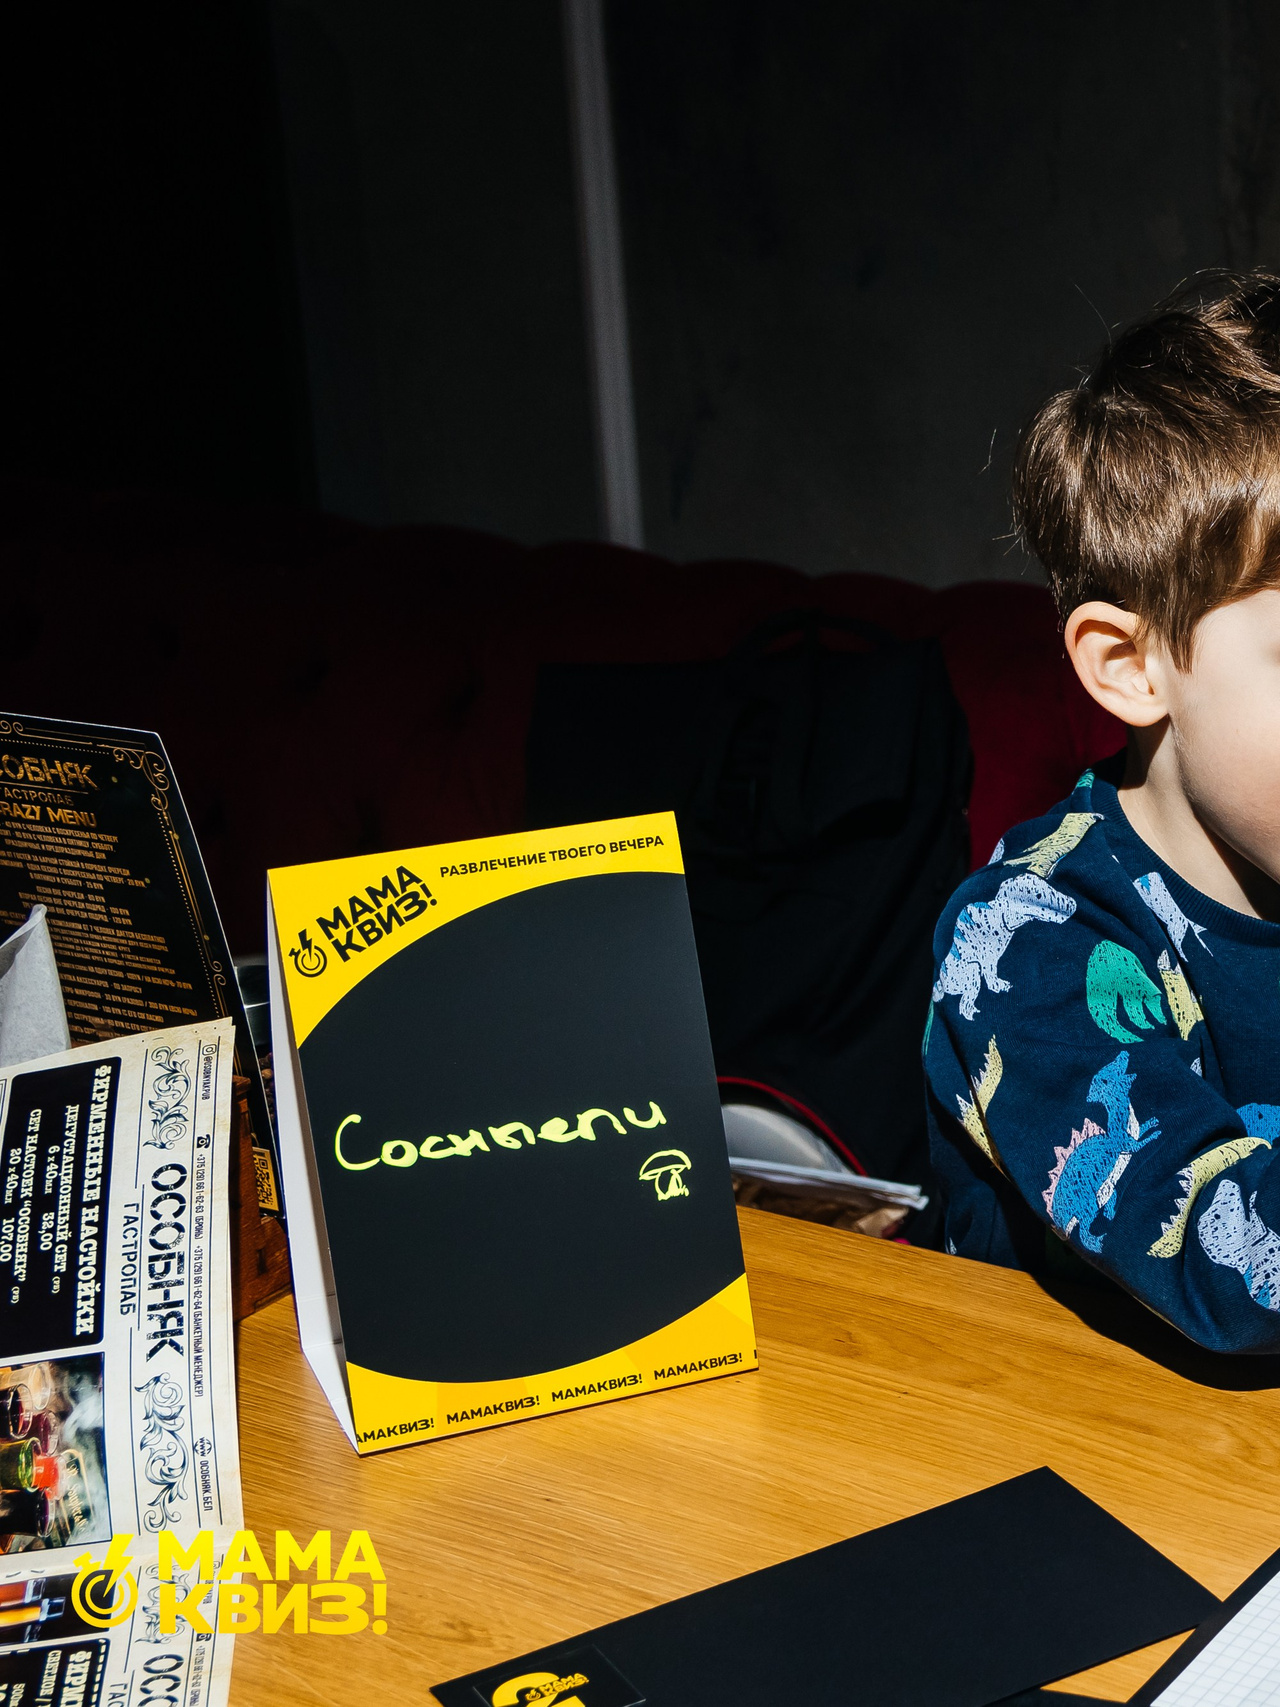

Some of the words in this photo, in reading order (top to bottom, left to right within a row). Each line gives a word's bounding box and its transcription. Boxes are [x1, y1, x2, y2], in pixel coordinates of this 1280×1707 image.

[0, 754, 100, 791] ОБНЯК
[0, 786, 75, 807] АСТРОПАБ
[0, 800, 41, 821] RAZY
[46, 806, 97, 829] MENU
[440, 851, 547, 878] РАЗВЛЕЧЕНИЕ
[549, 842, 607, 861] ТВОЕГО
[609, 835, 664, 854] ВЕЧЕРА
[316, 865, 423, 942] МАМА
[331, 883, 439, 962] КВИЗ!
[27, 1109, 42, 1132] СЕТ
[82, 1065, 112, 1202] ФИРМЕННЫЕ
[9, 1147, 22, 1164] 20
[20, 1133, 39, 1198] НАСТОЕК
[48, 1145, 60, 1154] 6
[196, 1154, 204, 1168] +375
[56, 1104, 79, 1242] ДЕГУСТАЦИОННЫЙ
[196, 1169, 205, 1181] (29)
[195, 1182, 204, 1214] 661-62-63
[0, 1217, 14, 1262] 107,00
[38, 1212, 54, 1251] 32,00
[54, 1244, 68, 1272] СЕТ
[75, 1205, 101, 1336] НАСТОЙКИ
[120, 1202, 139, 1315] ГАСТРОПАБ
[146, 1163, 188, 1362] ОСОБНЯК
[194, 1246, 203, 1260] +375
[194, 1262, 203, 1275] (29)
[194, 1276, 203, 1310] 661-62-64
[355, 1417, 435, 1444] АМАКВИЗ!
[446, 1395, 541, 1425] МАМАКВИЗ!
[551, 1372, 643, 1402] МАМАКВИЗ!
[653, 1352, 744, 1381] МАМАКВИЗ!
[200, 1460, 213, 1511] ОСОБНЯК.БЕЛ
